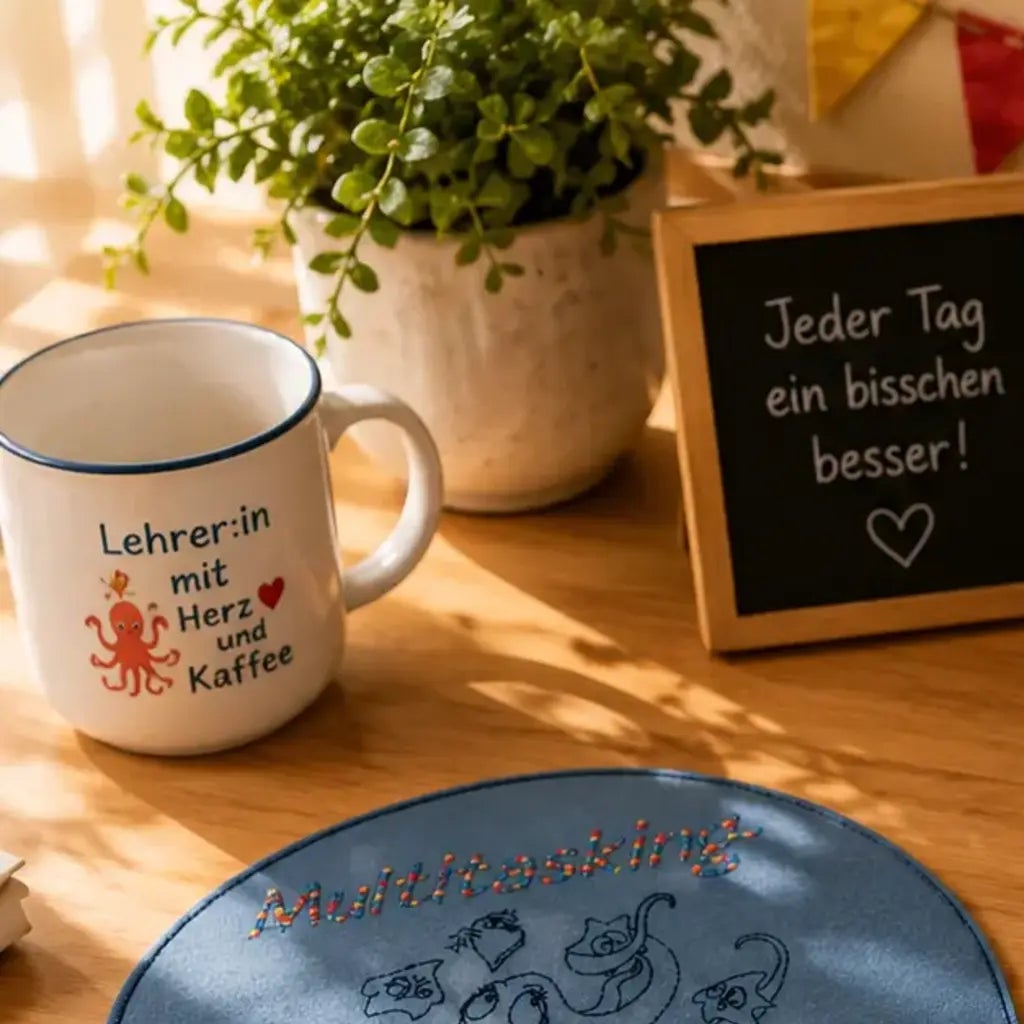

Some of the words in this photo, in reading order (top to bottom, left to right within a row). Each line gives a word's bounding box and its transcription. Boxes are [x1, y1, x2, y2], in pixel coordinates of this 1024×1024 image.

[764, 292, 893, 350] Jeder
[906, 284, 986, 353] Tag
[766, 374, 828, 418] ein
[844, 355, 1006, 410] bisschen
[811, 419, 969, 484] besser!
[99, 505, 270, 556] Lehrer:in
[171, 558, 229, 595] mit
[177, 597, 253, 632] Herz
[217, 618, 267, 651] und
[189, 645, 293, 693] Kaffee
[247, 813, 763, 941] Multitasking
